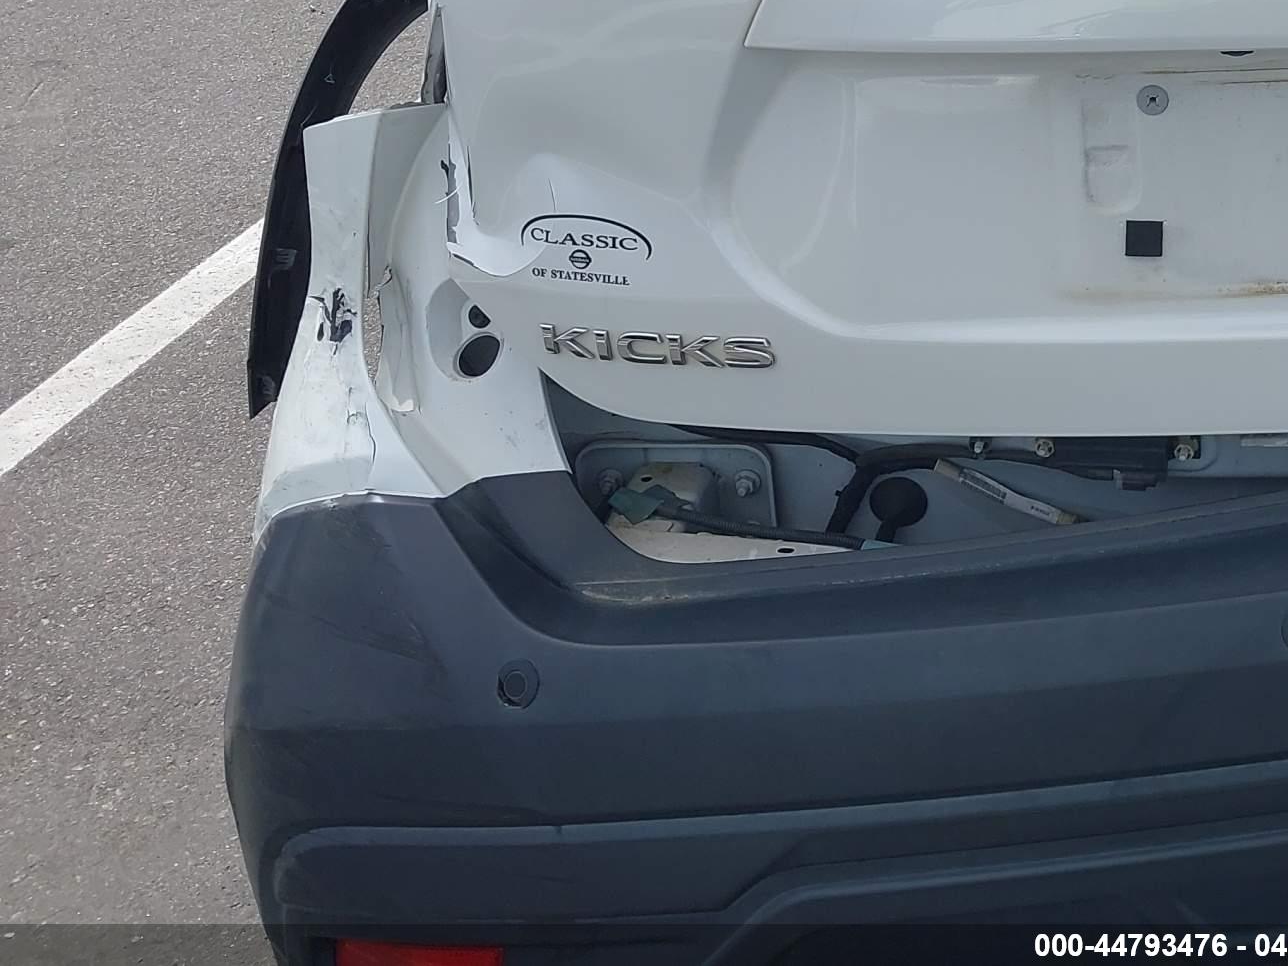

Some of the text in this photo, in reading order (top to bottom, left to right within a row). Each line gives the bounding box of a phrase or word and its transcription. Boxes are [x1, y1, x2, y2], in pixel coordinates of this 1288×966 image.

[530, 227, 638, 251] CLASSIC
[531, 267, 630, 285] OF STATESVILLE
[538, 322, 776, 370] KICKS
